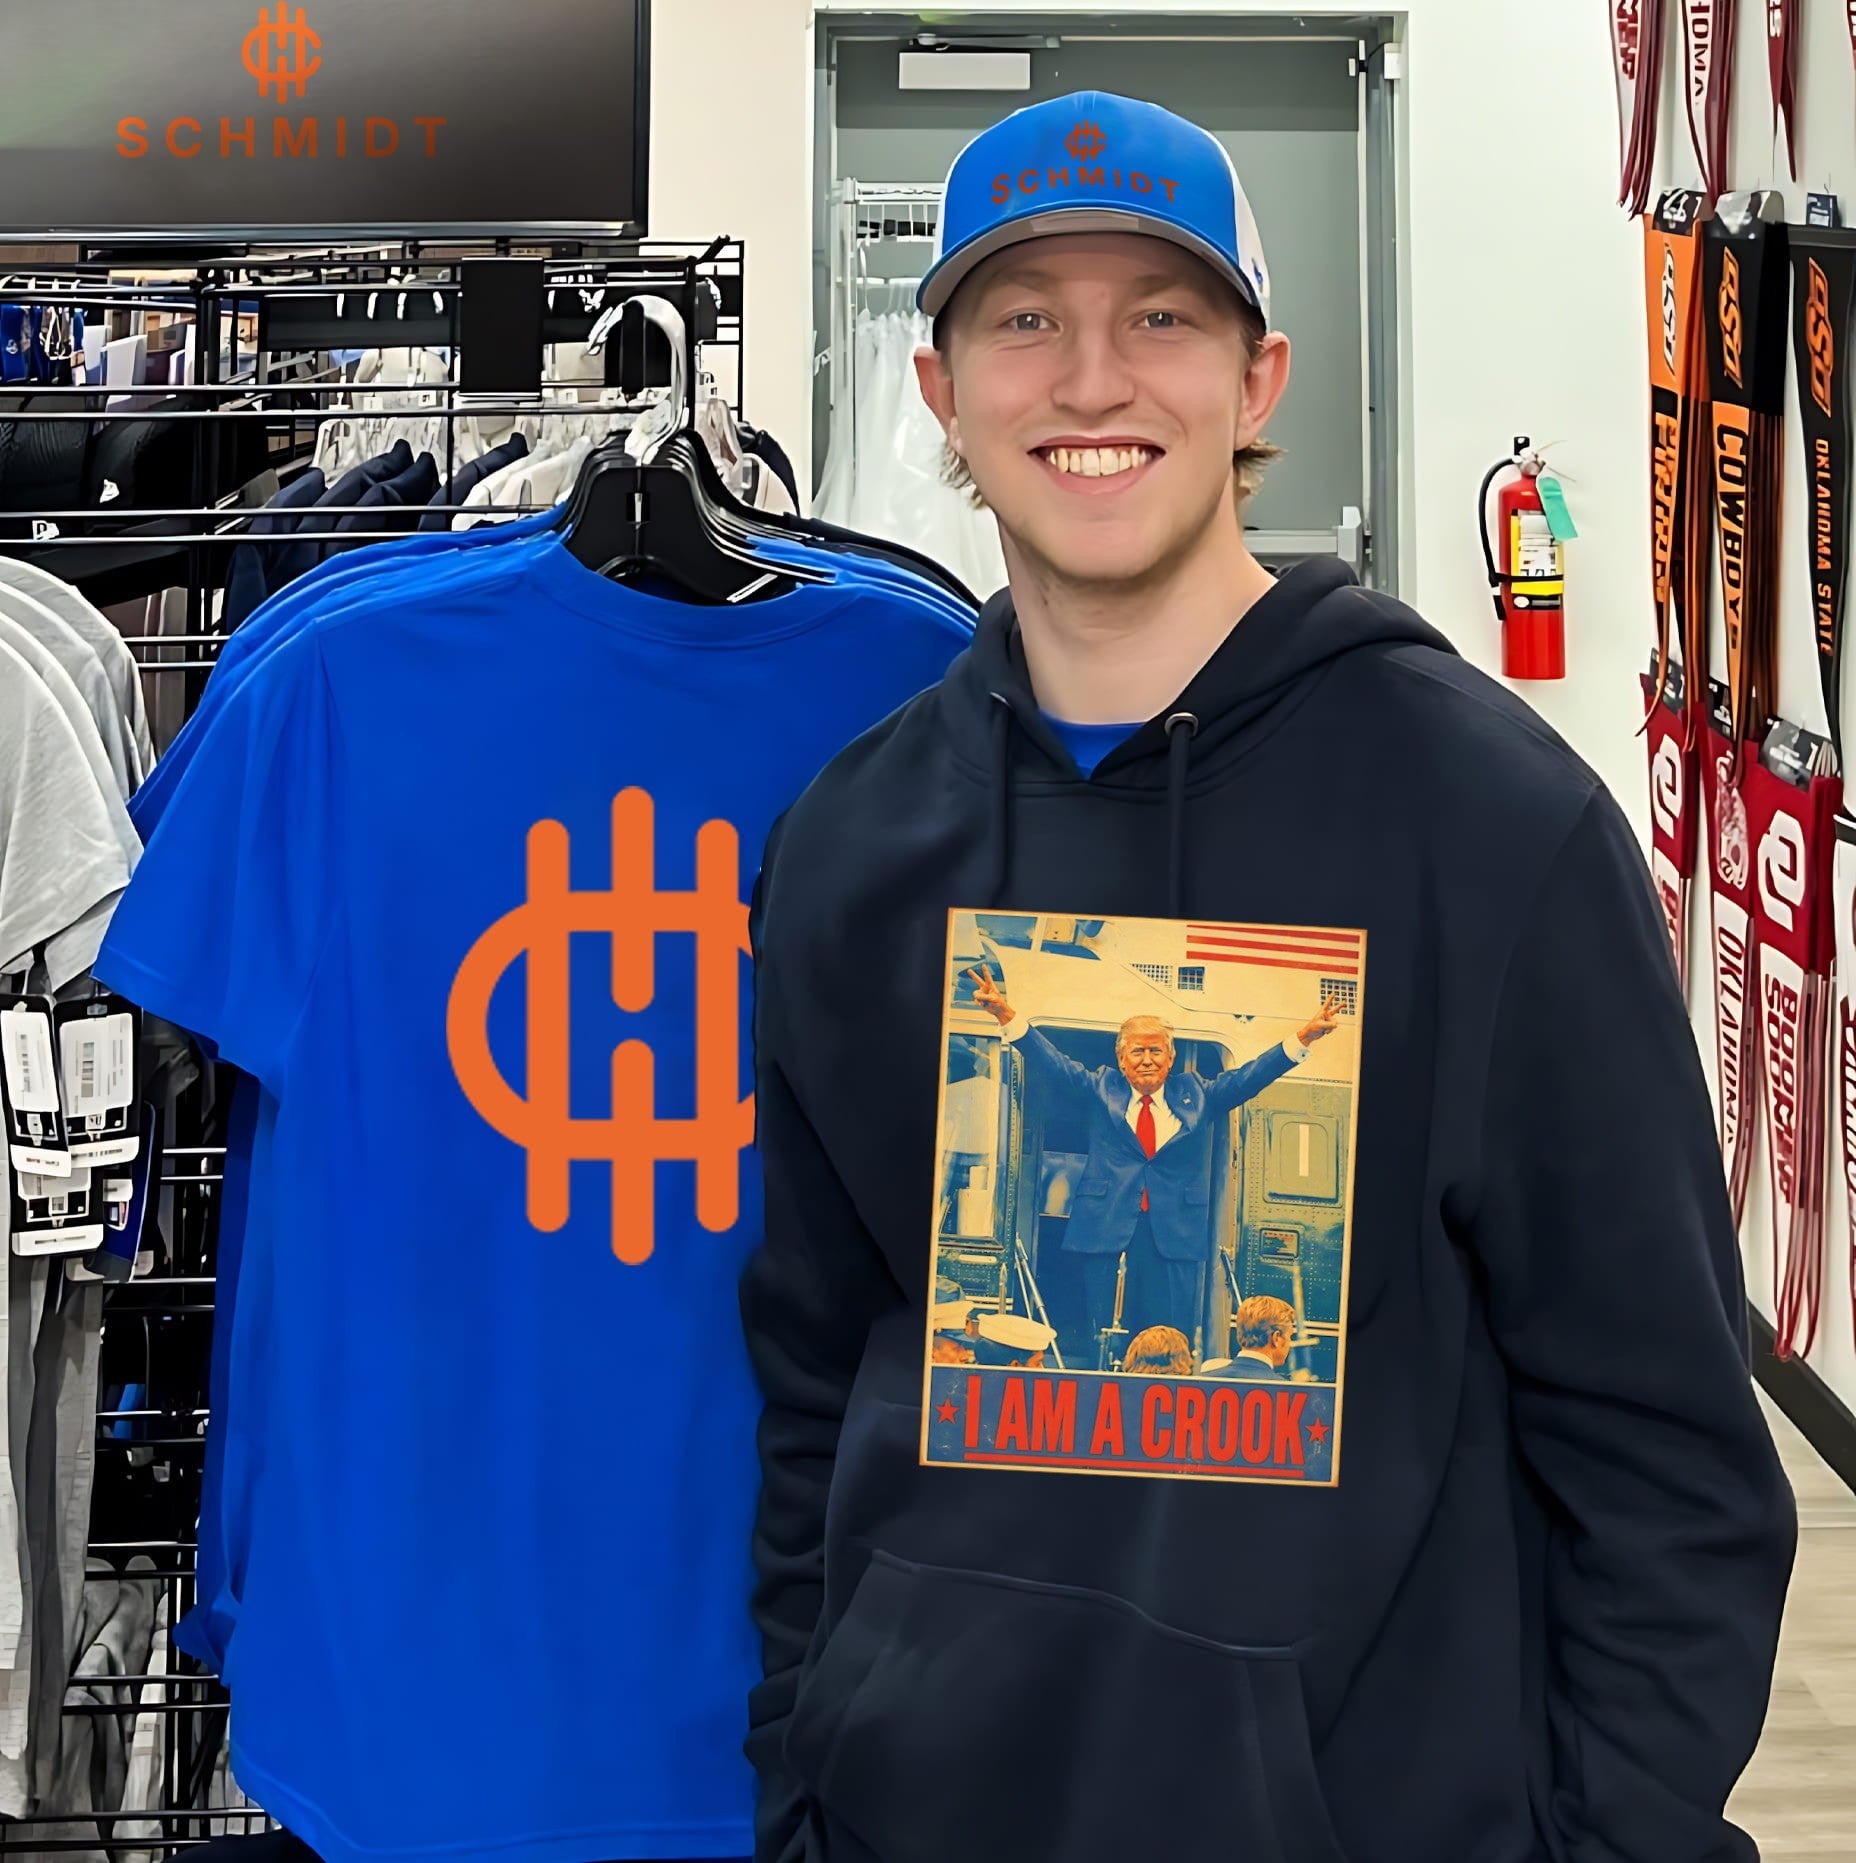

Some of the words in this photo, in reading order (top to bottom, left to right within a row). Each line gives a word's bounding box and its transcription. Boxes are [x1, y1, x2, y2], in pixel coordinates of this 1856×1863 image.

[115, 116, 448, 159] SCHMIDT
[991, 166, 1180, 205] SCHMIDT
[1815, 438, 1832, 570] OKLAHOMA
[964, 1375, 982, 1448] I
[994, 1377, 1077, 1453] AM
[1090, 1382, 1125, 1456] A
[1141, 1384, 1308, 1465] CROOK
